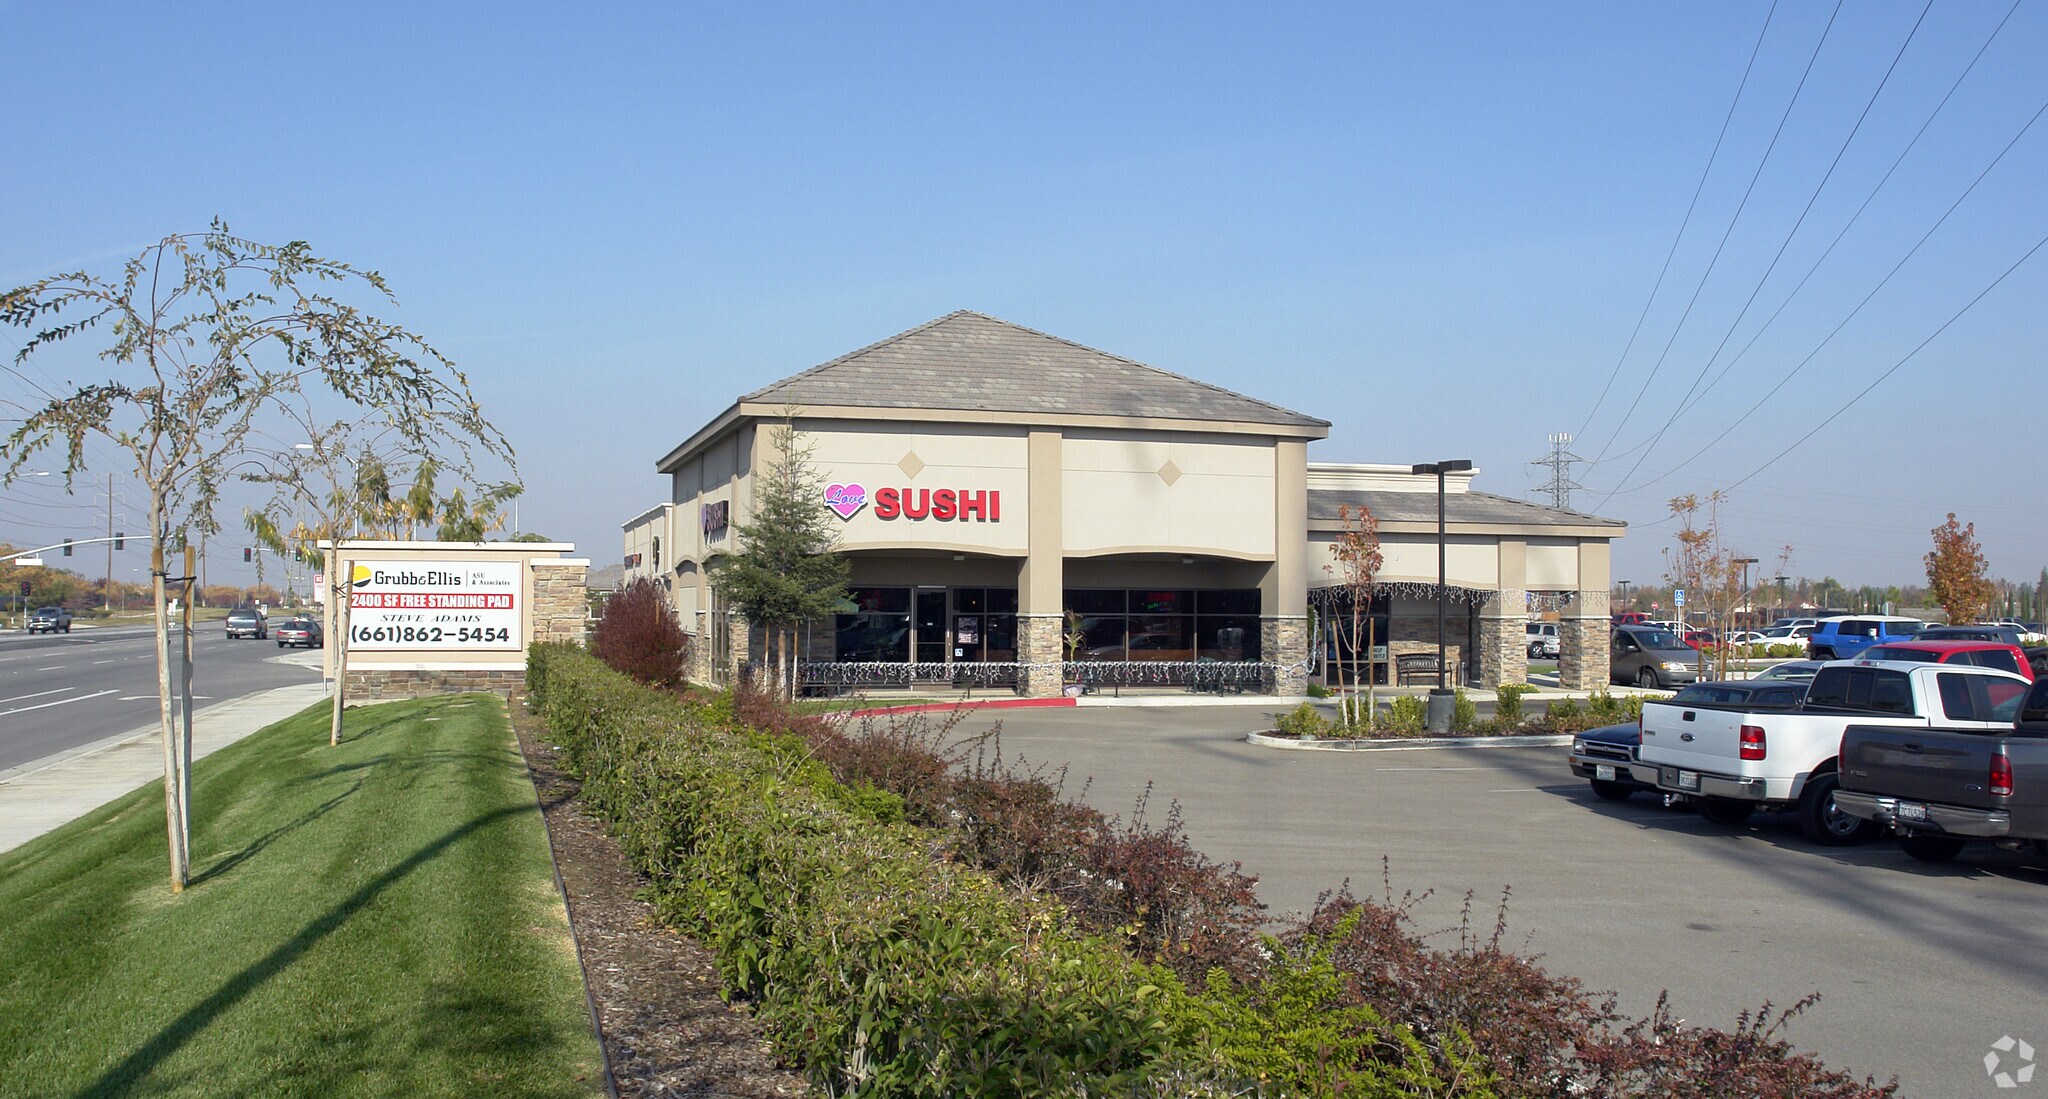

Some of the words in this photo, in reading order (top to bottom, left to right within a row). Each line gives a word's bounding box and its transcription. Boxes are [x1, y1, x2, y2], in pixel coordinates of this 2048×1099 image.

[826, 489, 866, 504] Love
[874, 487, 1000, 522] SUSHI
[375, 571, 461, 586] Grubb&Ellis
[351, 593, 382, 607] 2400
[384, 594, 400, 607] SF
[400, 594, 427, 608] FREE
[428, 595, 486, 608] STANDING
[487, 595, 510, 608] PAD
[380, 614, 424, 622] STEVE
[351, 625, 510, 643] (661)862-5454
